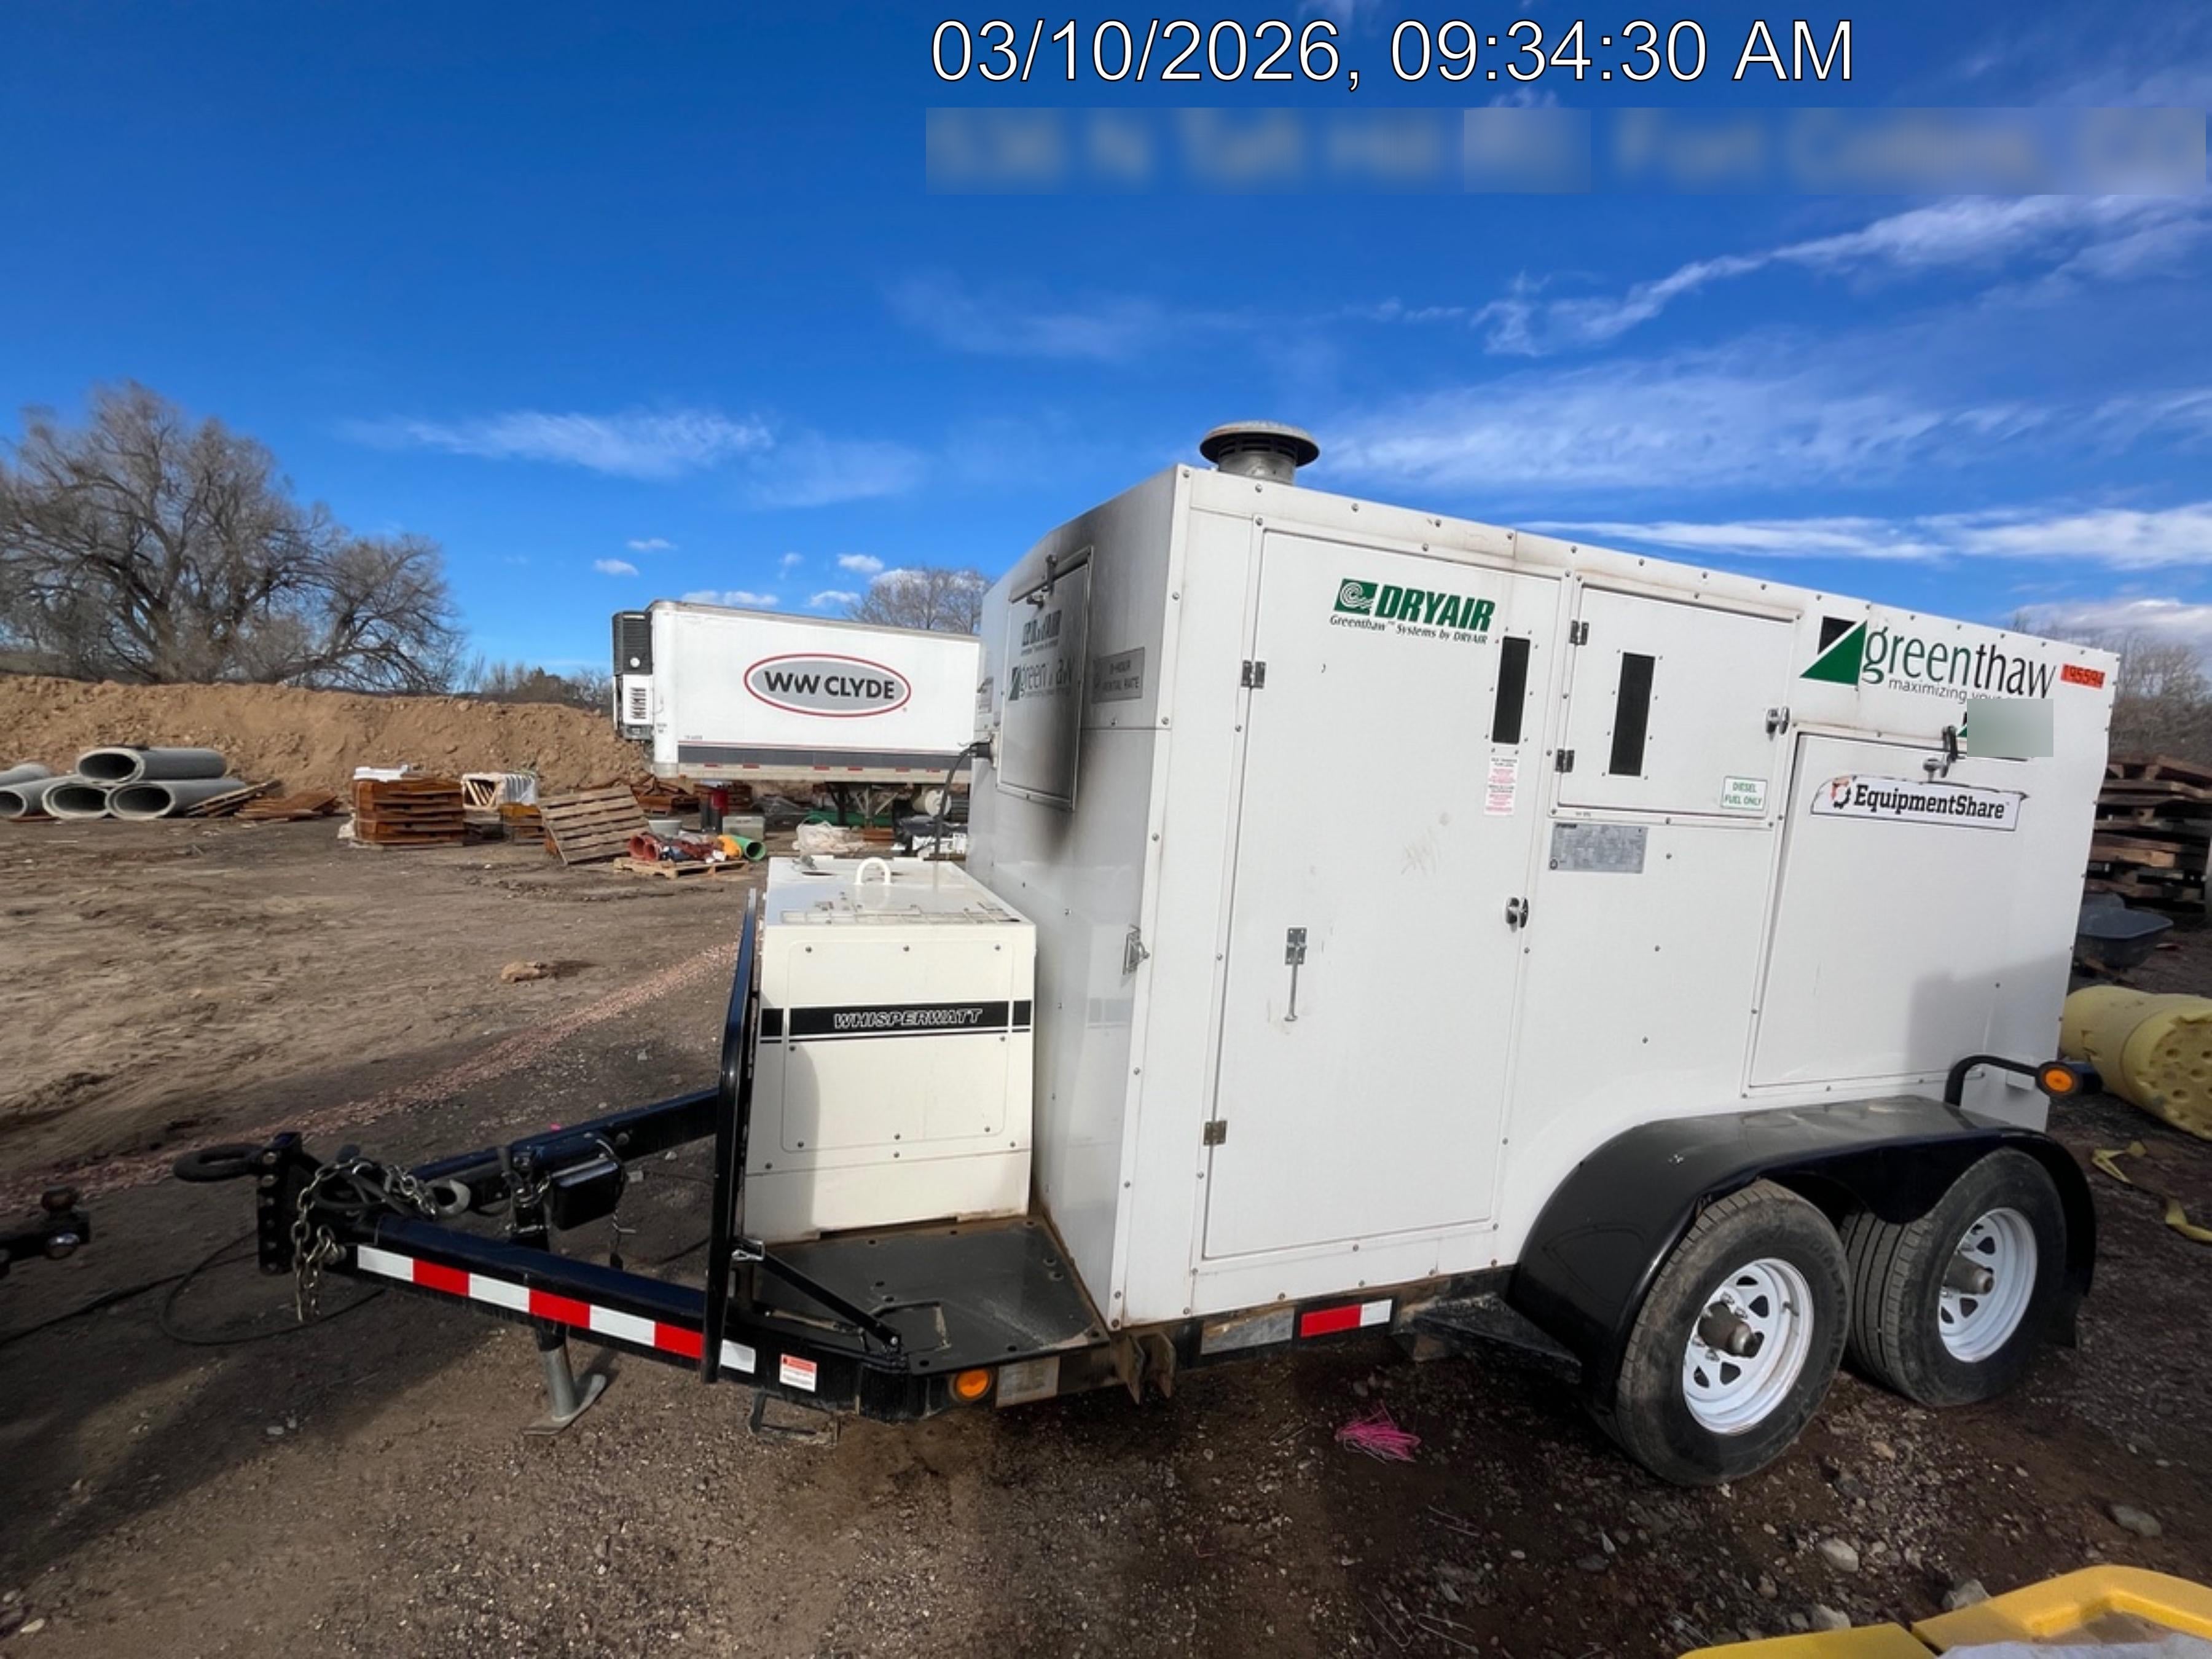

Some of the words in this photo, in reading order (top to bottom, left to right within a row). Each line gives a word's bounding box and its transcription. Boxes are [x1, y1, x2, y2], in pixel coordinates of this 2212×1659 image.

[1375, 584, 1496, 632] DRYAIR
[1396, 624, 1437, 638] Systems
[1439, 629, 1450, 640] by
[1453, 632, 1488, 645] DRYAIR
[1861, 626, 2057, 699] greenthaw
[764, 670, 821, 695] WW
[823, 675, 895, 699] CLYDE
[1888, 678, 1967, 704] maximizing
[1724, 794, 1741, 804] FUEL
[1743, 796, 1763, 806] ONLY
[1732, 782, 1757, 793] DIESEL
[1854, 784, 2005, 819] EquipmentShare
[834, 1008, 983, 1029] WHISPERWATT
